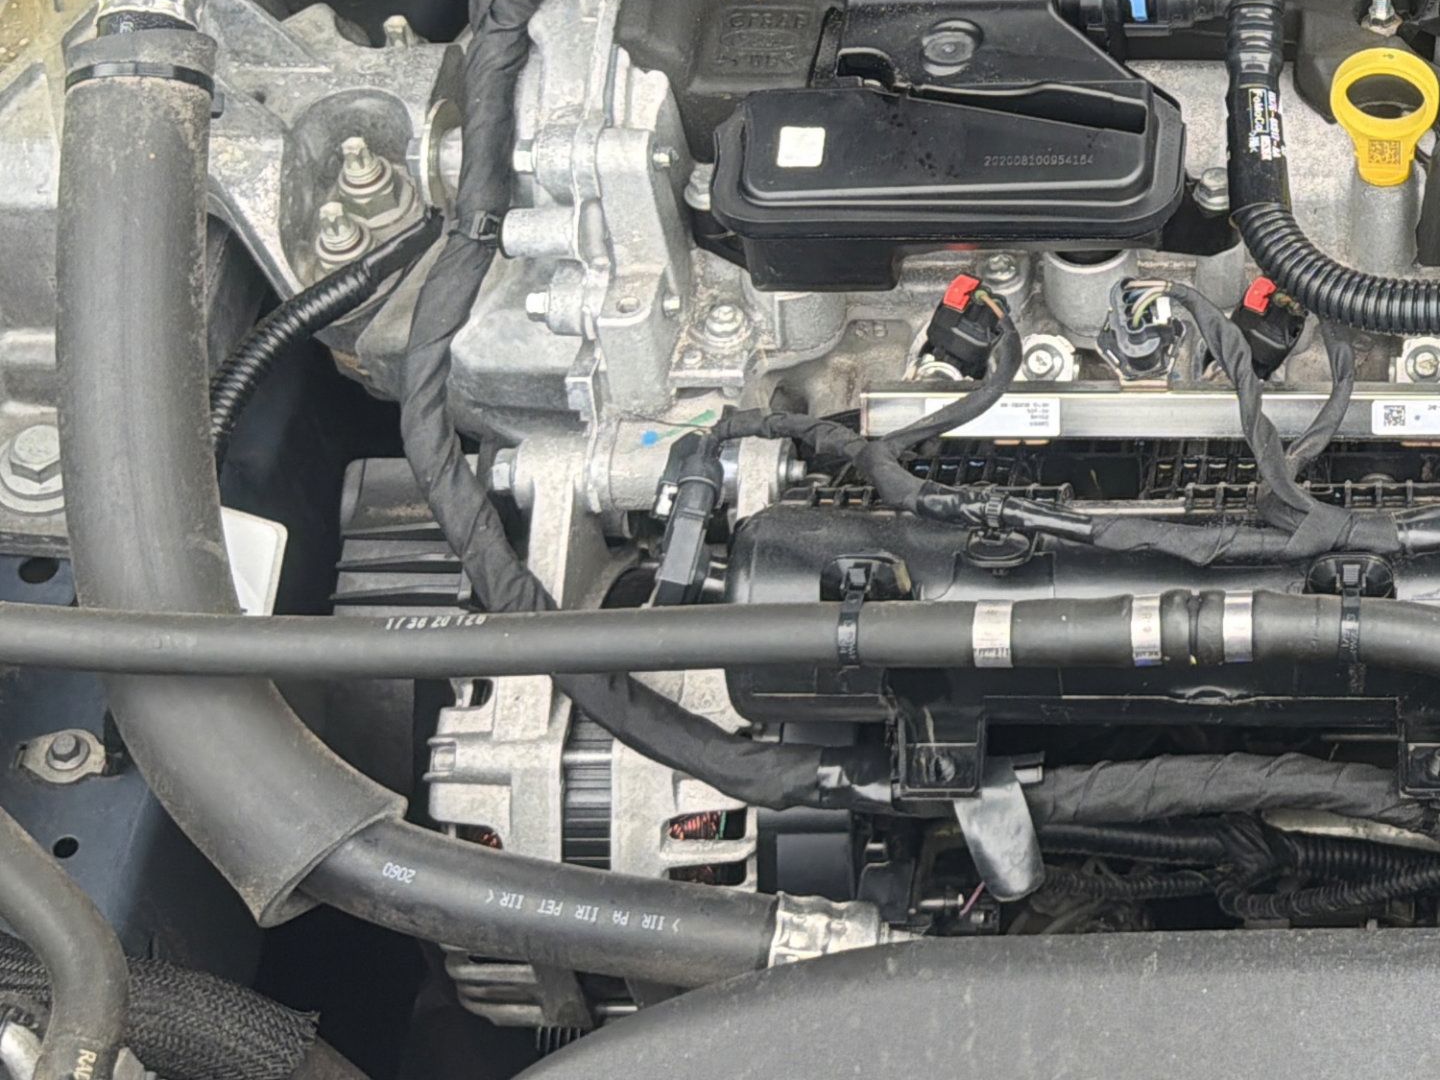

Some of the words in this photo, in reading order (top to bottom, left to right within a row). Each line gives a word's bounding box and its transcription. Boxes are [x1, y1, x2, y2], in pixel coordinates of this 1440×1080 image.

[1250, 91, 1265, 130] FoMoCo
[383, 861, 417, 884] 2060
[536, 898, 564, 917] PET
[611, 910, 630, 927] PA
